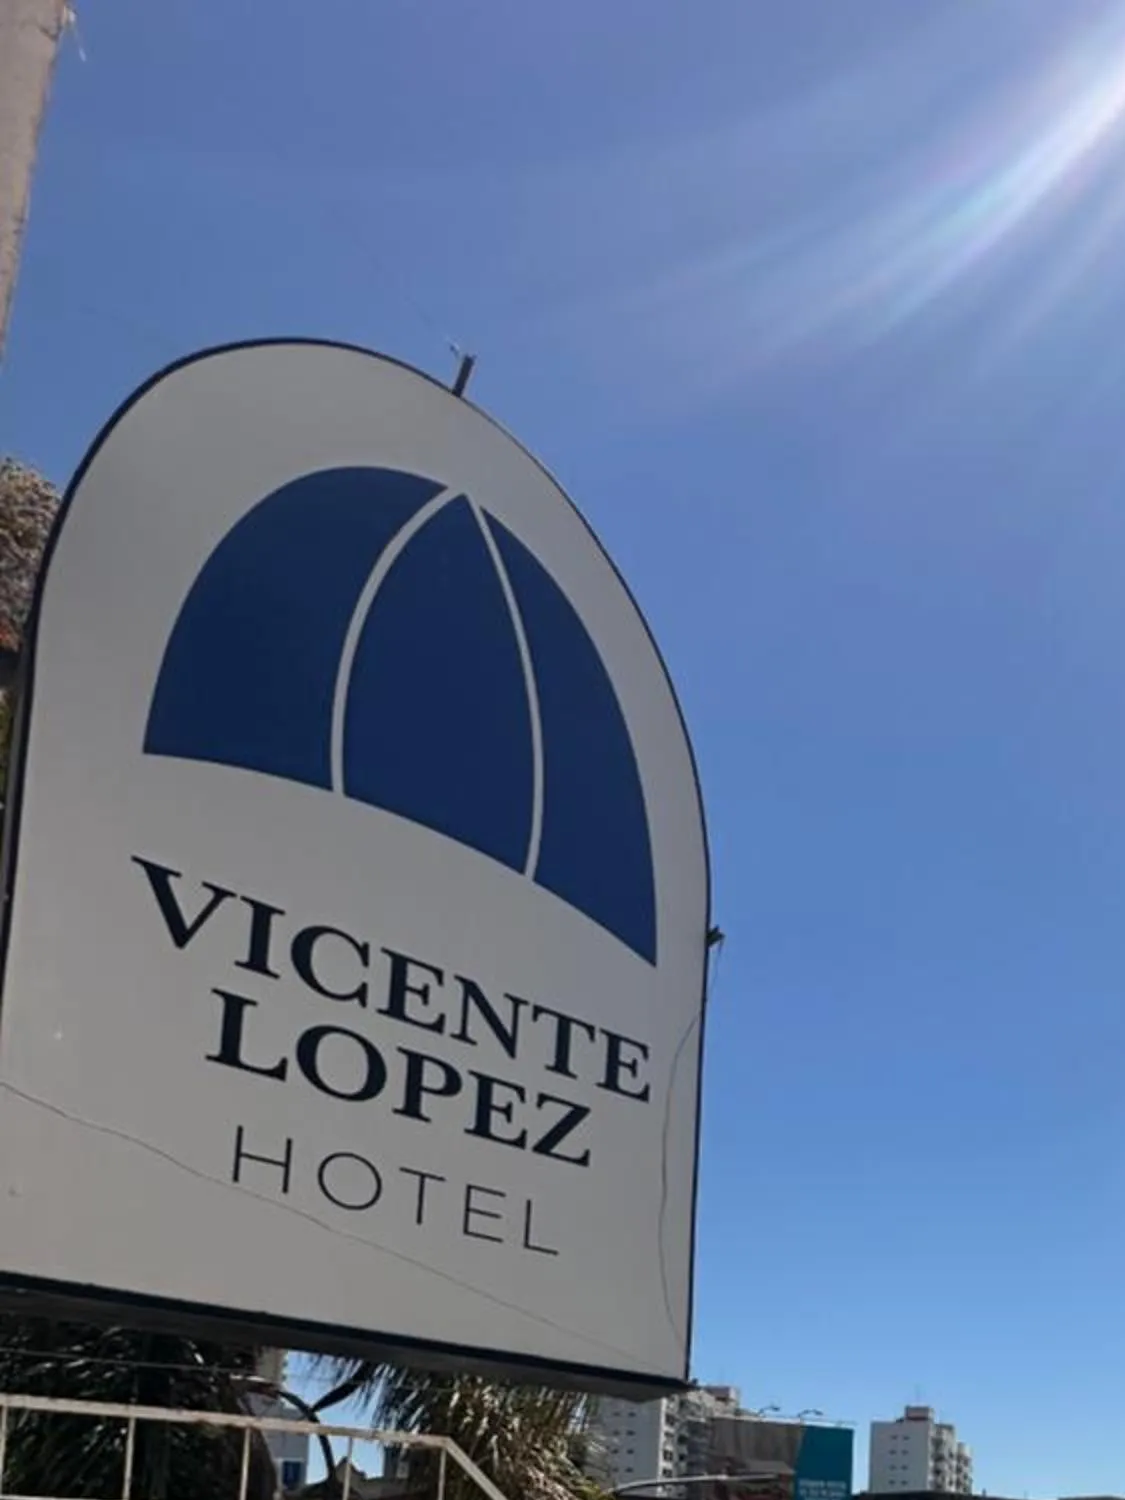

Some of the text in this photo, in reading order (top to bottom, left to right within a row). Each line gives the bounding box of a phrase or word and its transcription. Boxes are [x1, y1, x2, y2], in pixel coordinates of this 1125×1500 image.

[130, 854, 652, 1104] VICENTE
[204, 987, 592, 1169] LOPEZ
[232, 1125, 559, 1257] HOTEL
